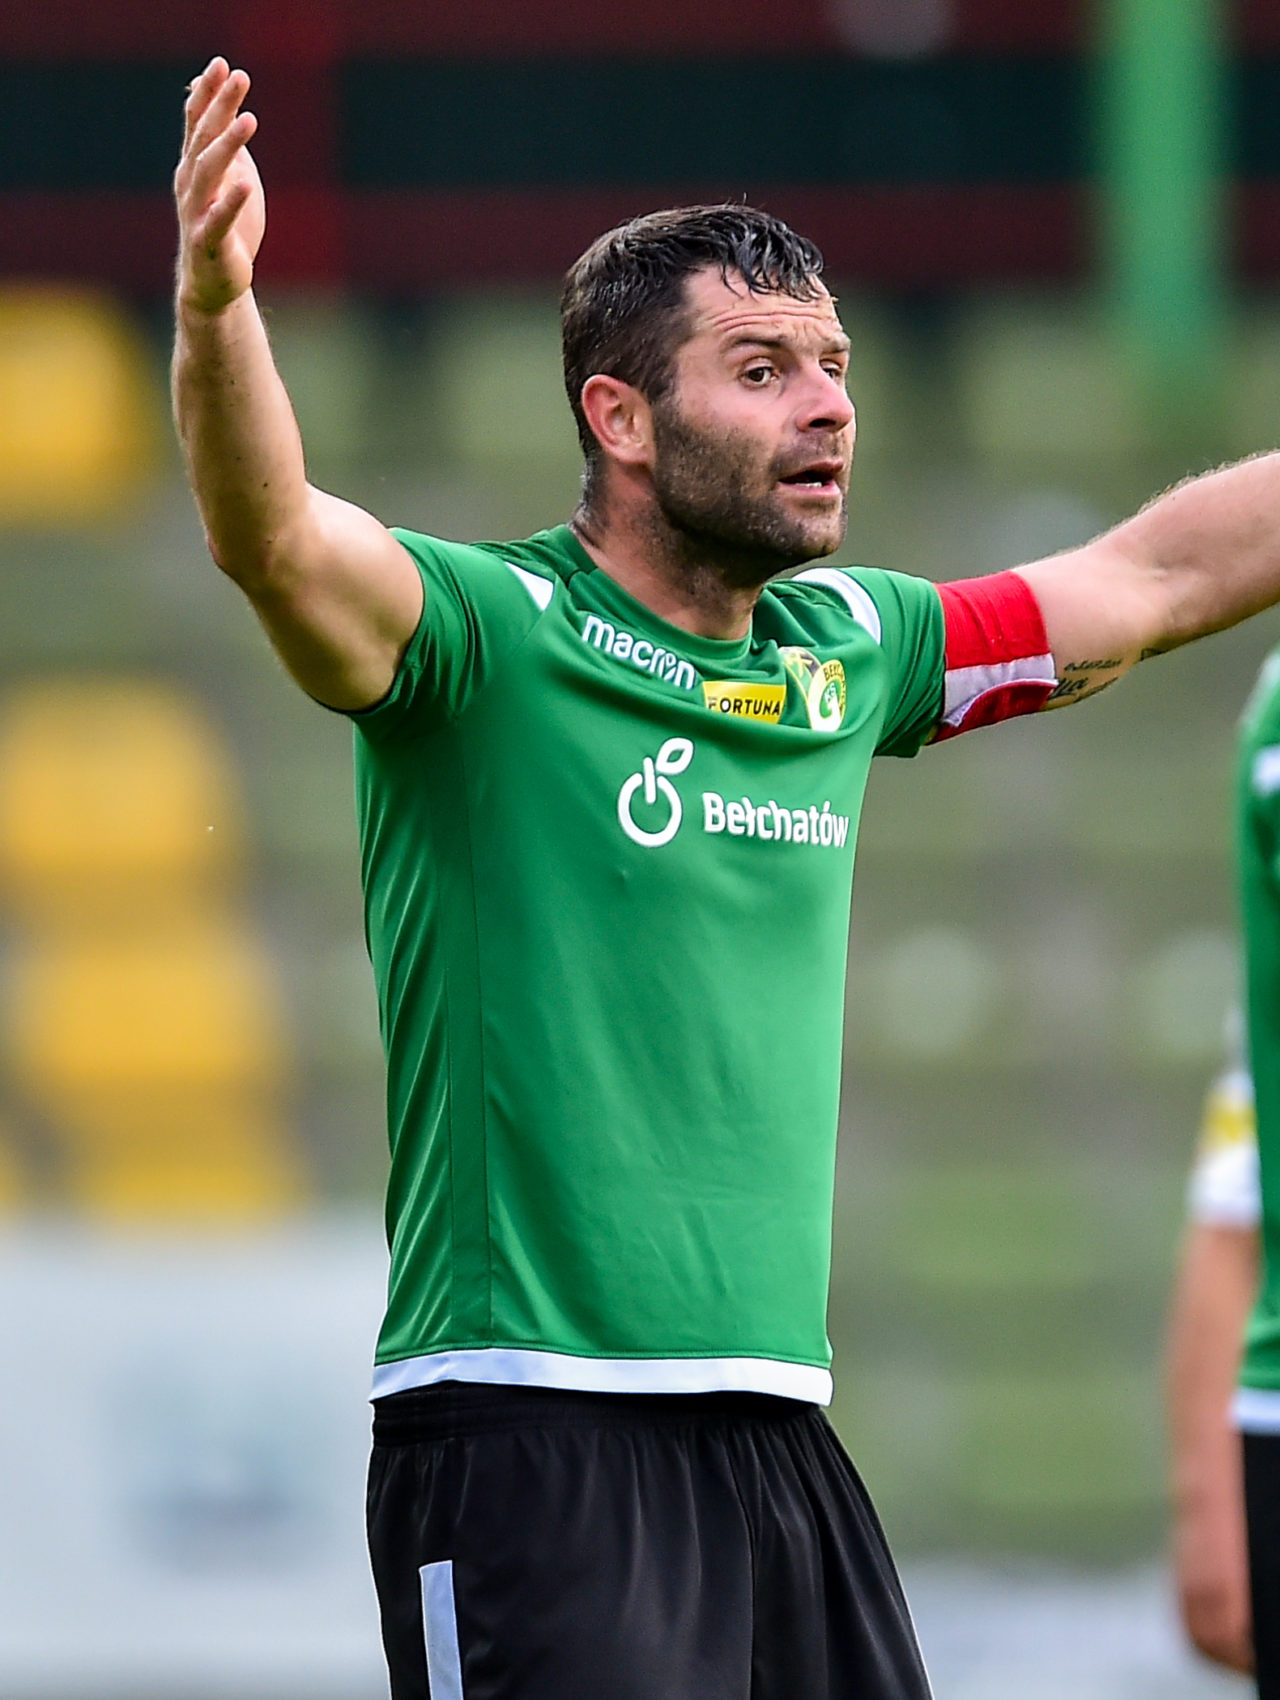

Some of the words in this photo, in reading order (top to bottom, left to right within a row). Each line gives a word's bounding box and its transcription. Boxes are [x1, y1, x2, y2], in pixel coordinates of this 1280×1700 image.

[582, 615, 696, 690] macron
[707, 696, 781, 716] FORTUNA
[702, 791, 849, 848] Bełchatów
